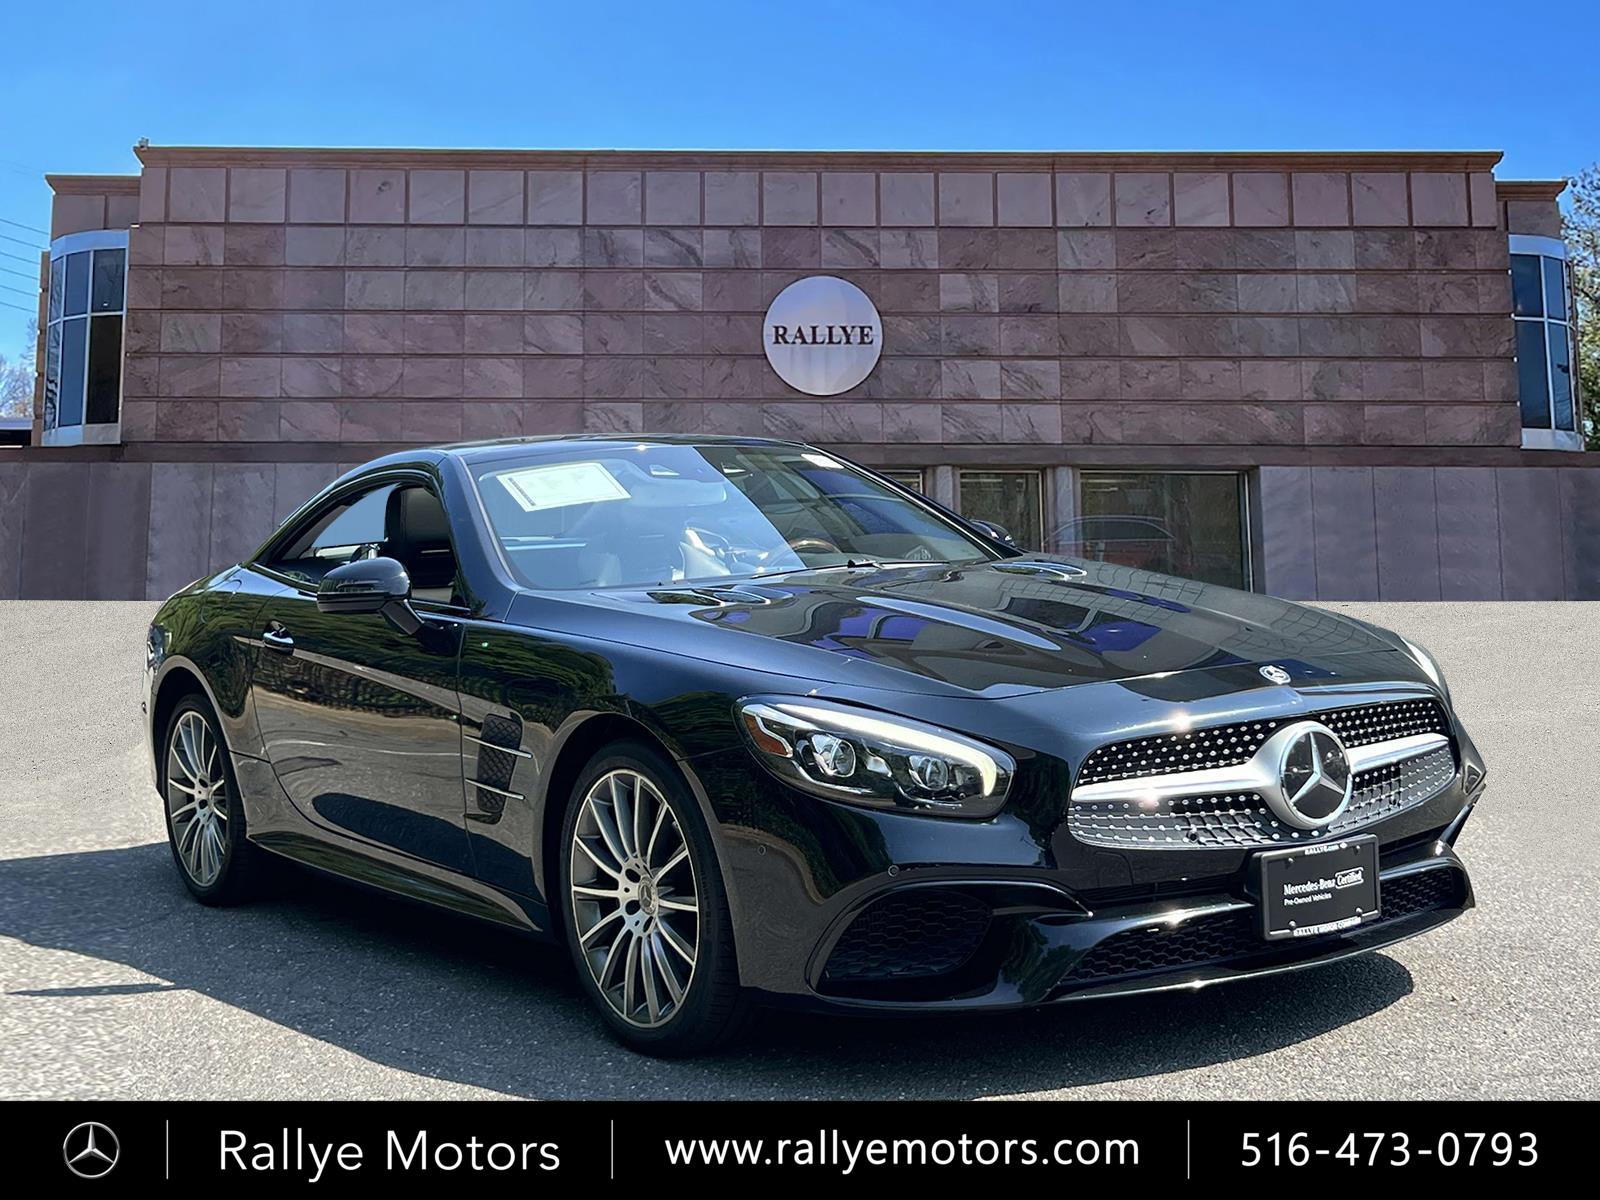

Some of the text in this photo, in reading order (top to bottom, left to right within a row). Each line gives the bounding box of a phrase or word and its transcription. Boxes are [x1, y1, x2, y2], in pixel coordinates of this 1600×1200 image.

[772, 325, 874, 345] RALLYE
[1283, 870, 1362, 896] Mercedes-Benz Certified
[1284, 892, 1332, 906] Pre-Owned Vehicles
